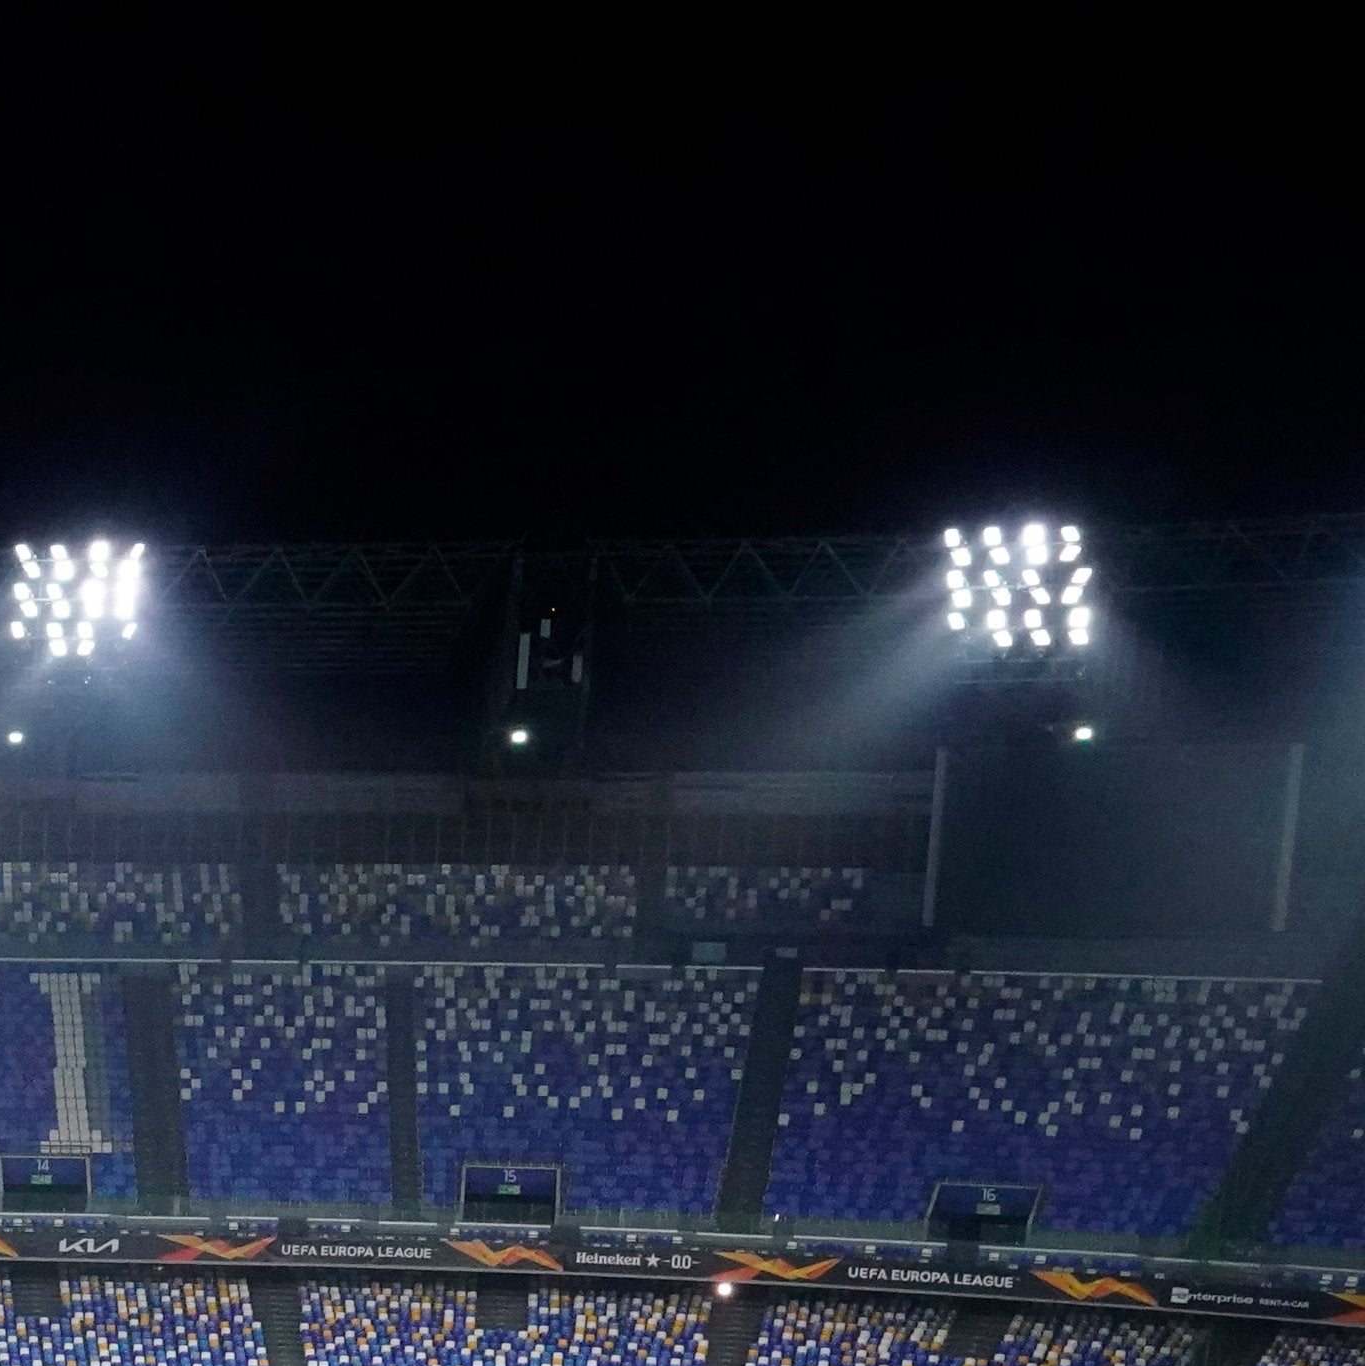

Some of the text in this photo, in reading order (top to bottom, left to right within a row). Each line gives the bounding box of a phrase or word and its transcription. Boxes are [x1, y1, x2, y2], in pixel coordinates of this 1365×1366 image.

[37, 1159, 50, 1171] 14
[504, 1169, 517, 1182] 15
[981, 1187, 996, 1201] 16
[281, 1244, 432, 1260] UEFA EUROPA LEAGUE
[575, 1251, 643, 1267] Heineken
[847, 1265, 1014, 1289] UEFA EUROPA LEAGUE
[1174, 1290, 1254, 1305] enterprise
